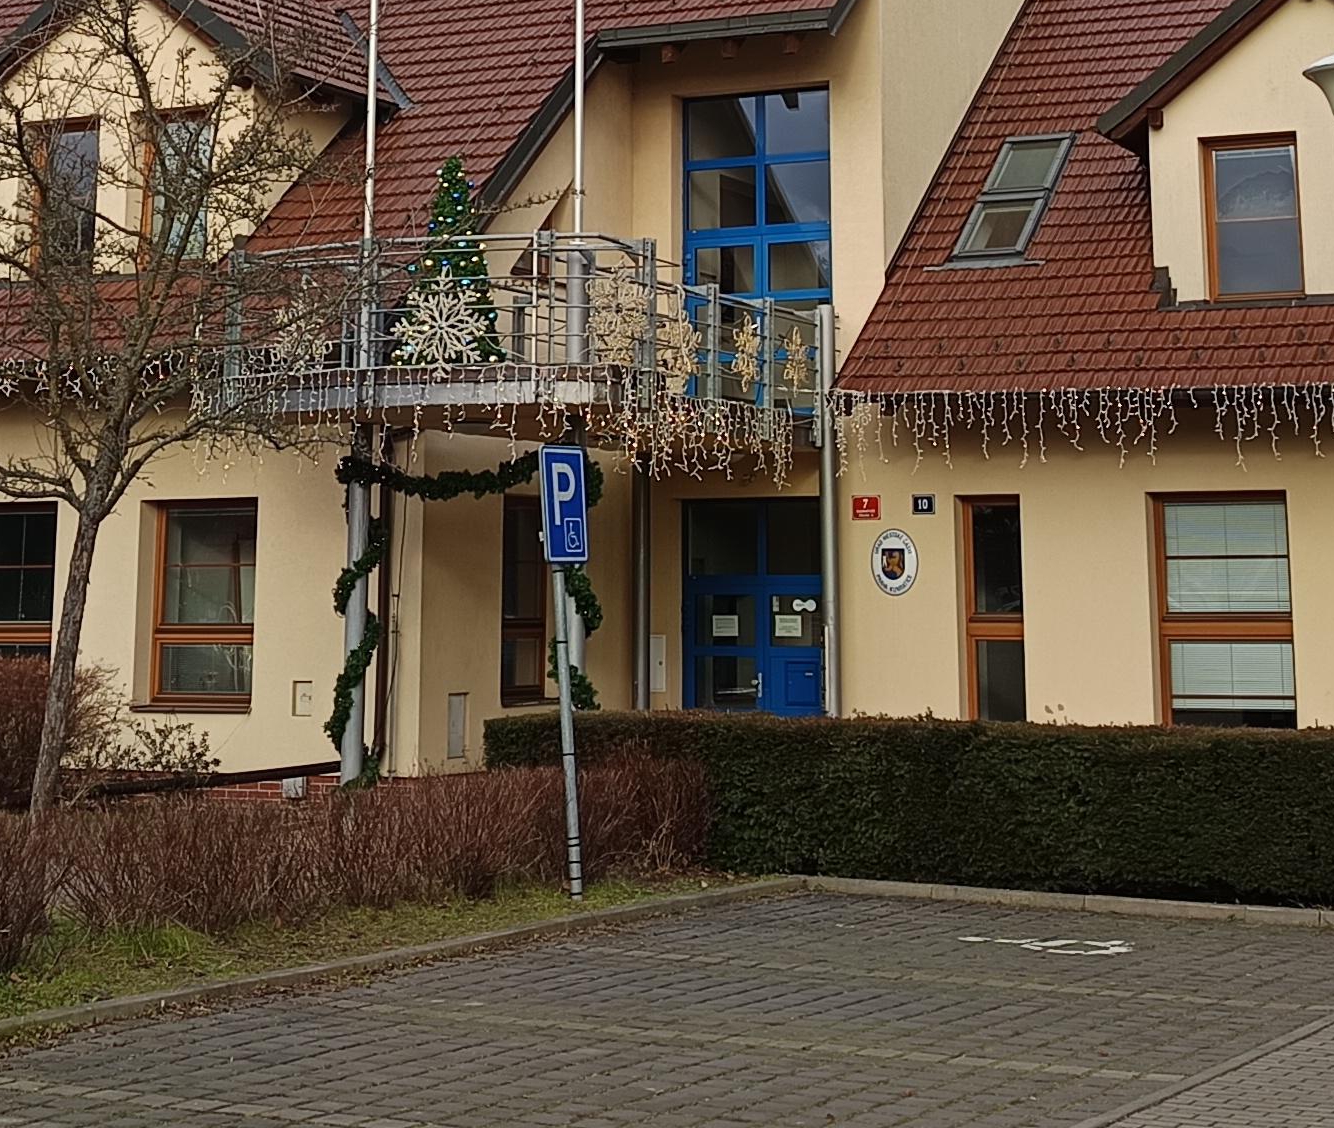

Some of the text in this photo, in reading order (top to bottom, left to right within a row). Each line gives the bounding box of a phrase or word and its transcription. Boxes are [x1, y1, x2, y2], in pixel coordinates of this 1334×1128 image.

[551, 462, 576, 526] P
[862, 498, 869, 509] 7
[918, 498, 928, 510] 10
